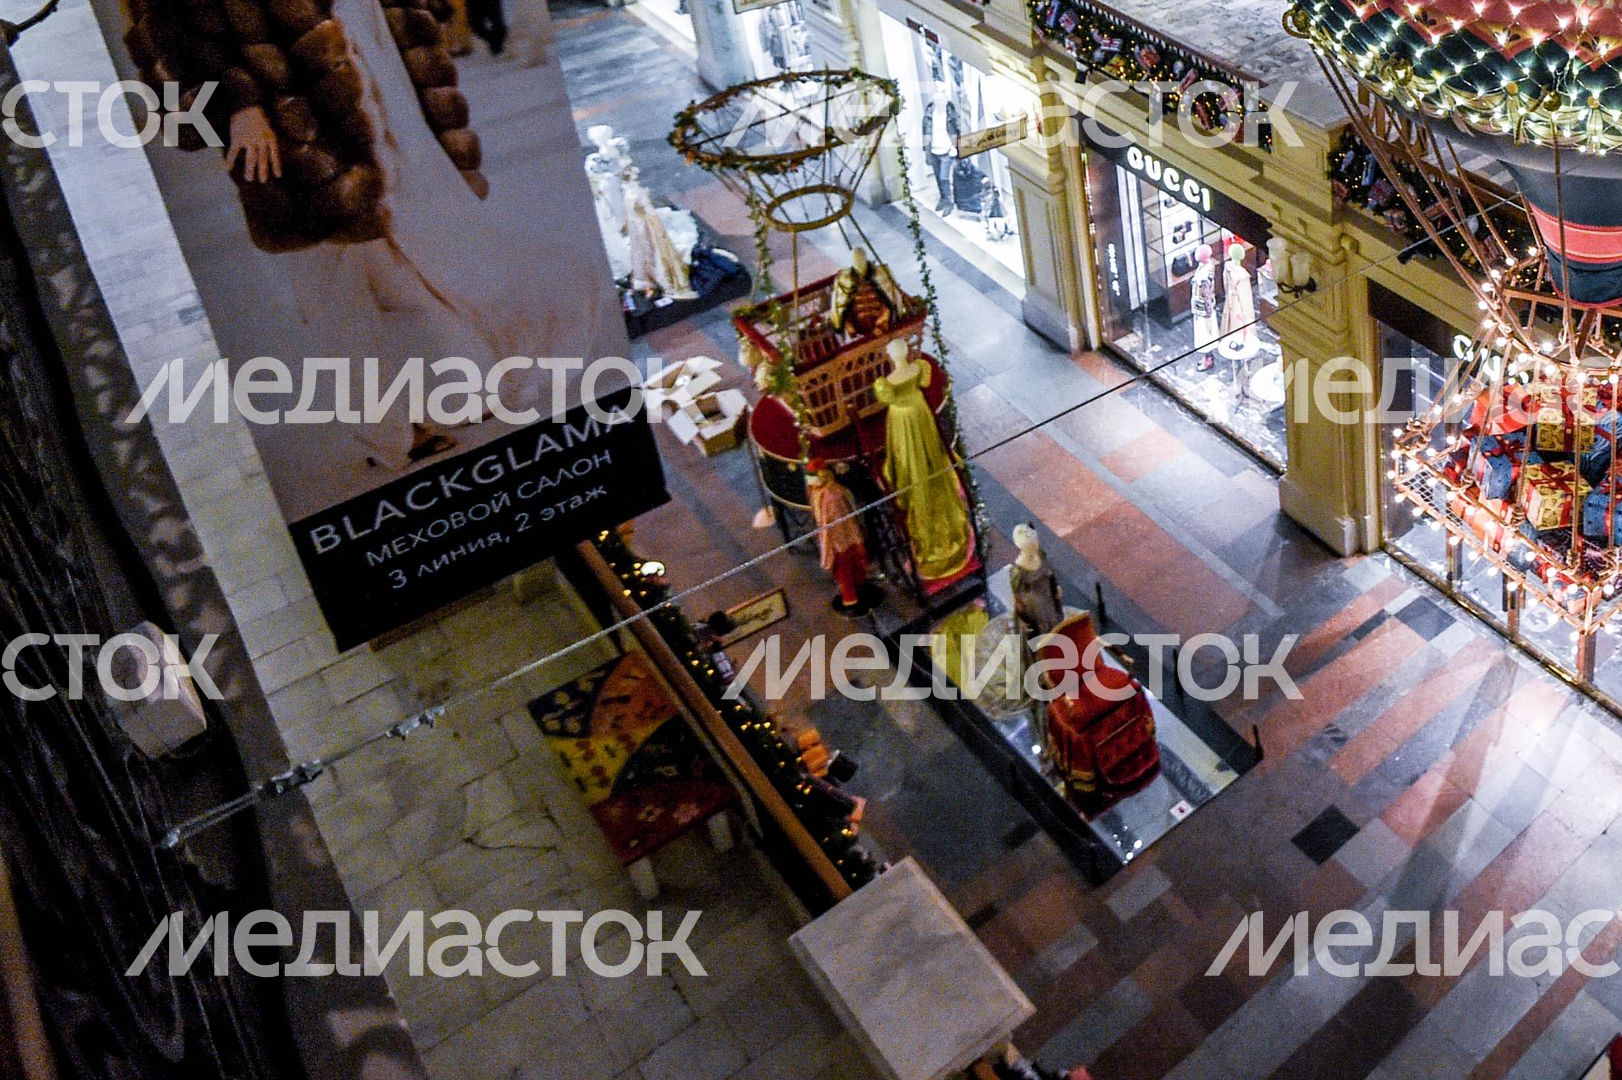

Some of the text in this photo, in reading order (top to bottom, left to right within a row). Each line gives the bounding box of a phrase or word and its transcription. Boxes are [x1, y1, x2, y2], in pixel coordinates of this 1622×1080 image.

[1126, 146, 1213, 212] GUCCI
[309, 405, 635, 555] BLACKGLAMA
[366, 449, 612, 568] МЕХОВОЙ САЛОН
[388, 569, 407, 590] 3
[515, 513, 532, 533] 2
[541, 485, 608, 522] этаж
